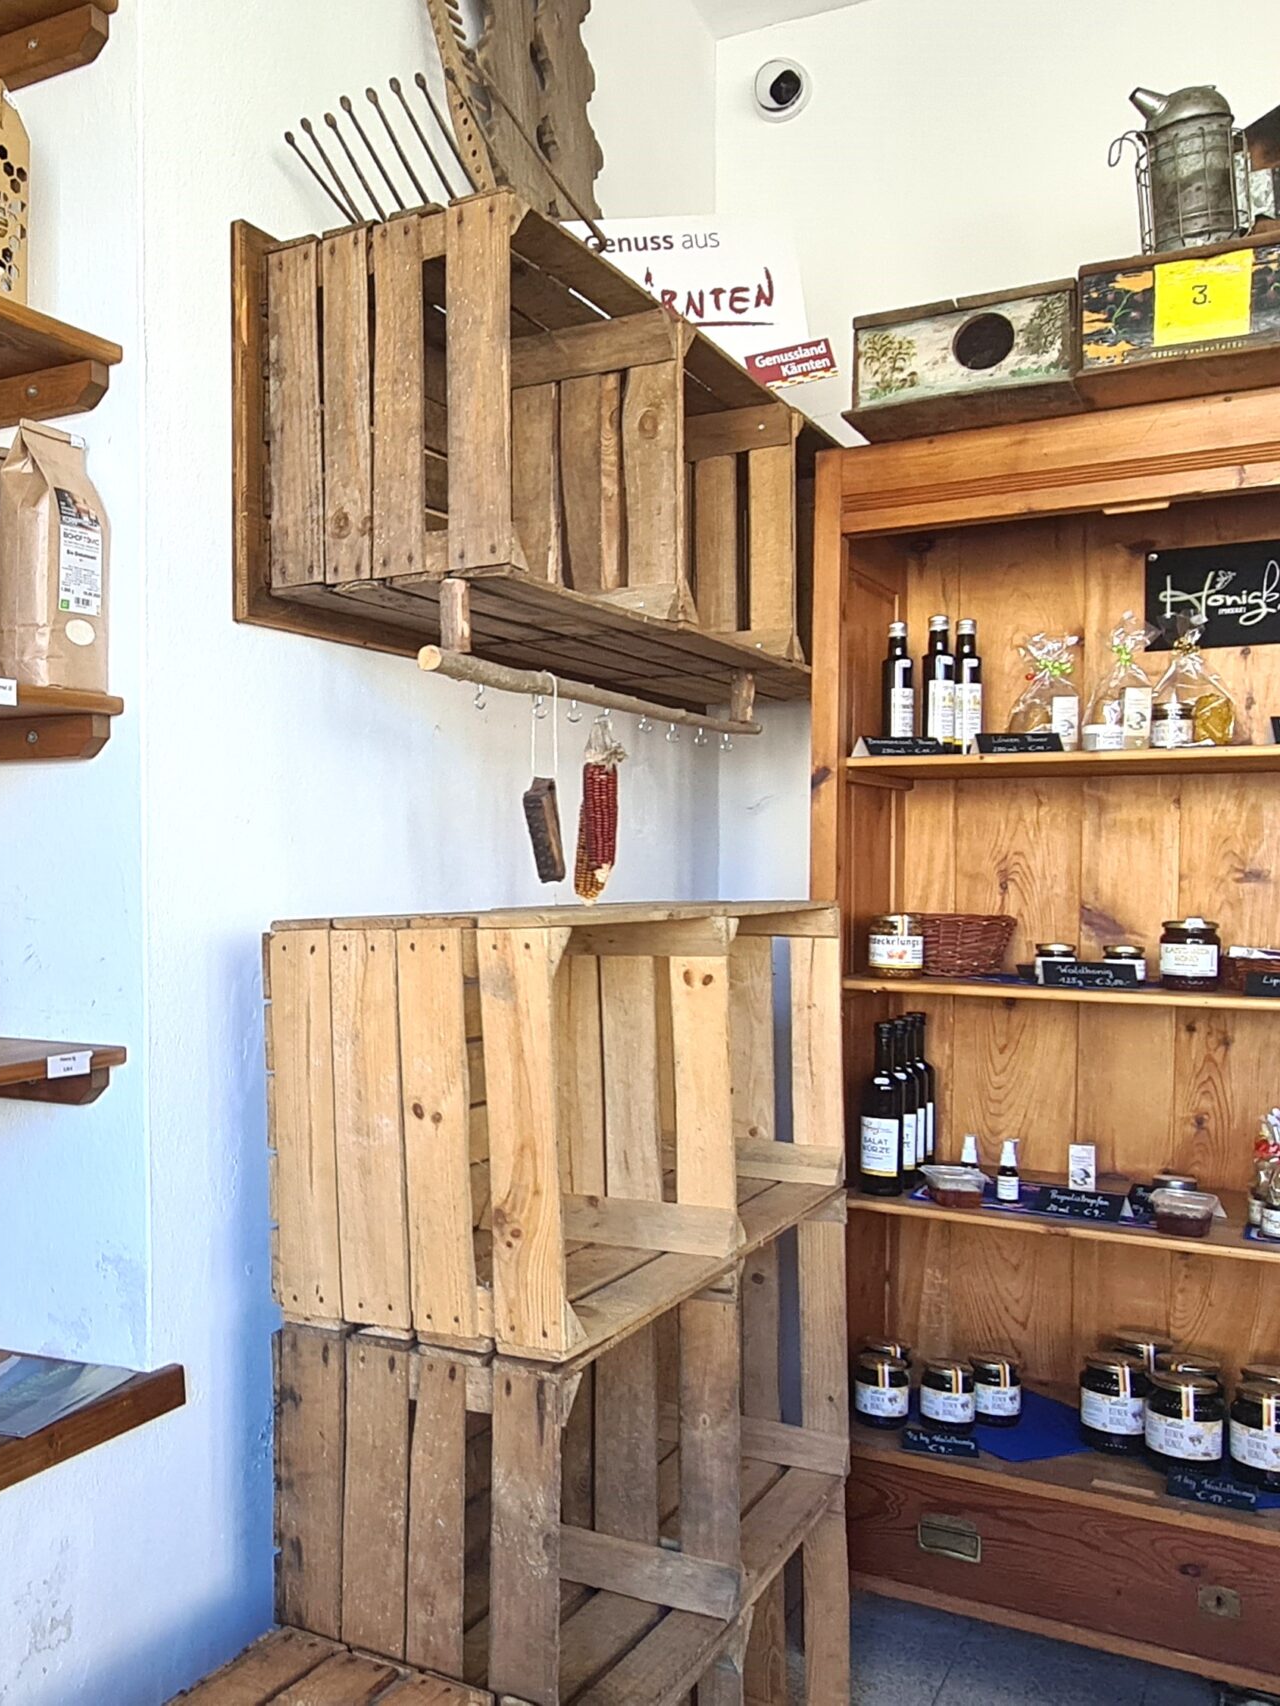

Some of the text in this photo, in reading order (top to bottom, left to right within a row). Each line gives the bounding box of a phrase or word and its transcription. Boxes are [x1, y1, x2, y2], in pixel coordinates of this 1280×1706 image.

[681, 232, 720, 249] aus
[645, 267, 774, 319] RNTEN
[1192, 284, 1212, 305] 3.
[754, 341, 828, 368] Genussland
[780, 357, 831, 377] Kärnten
